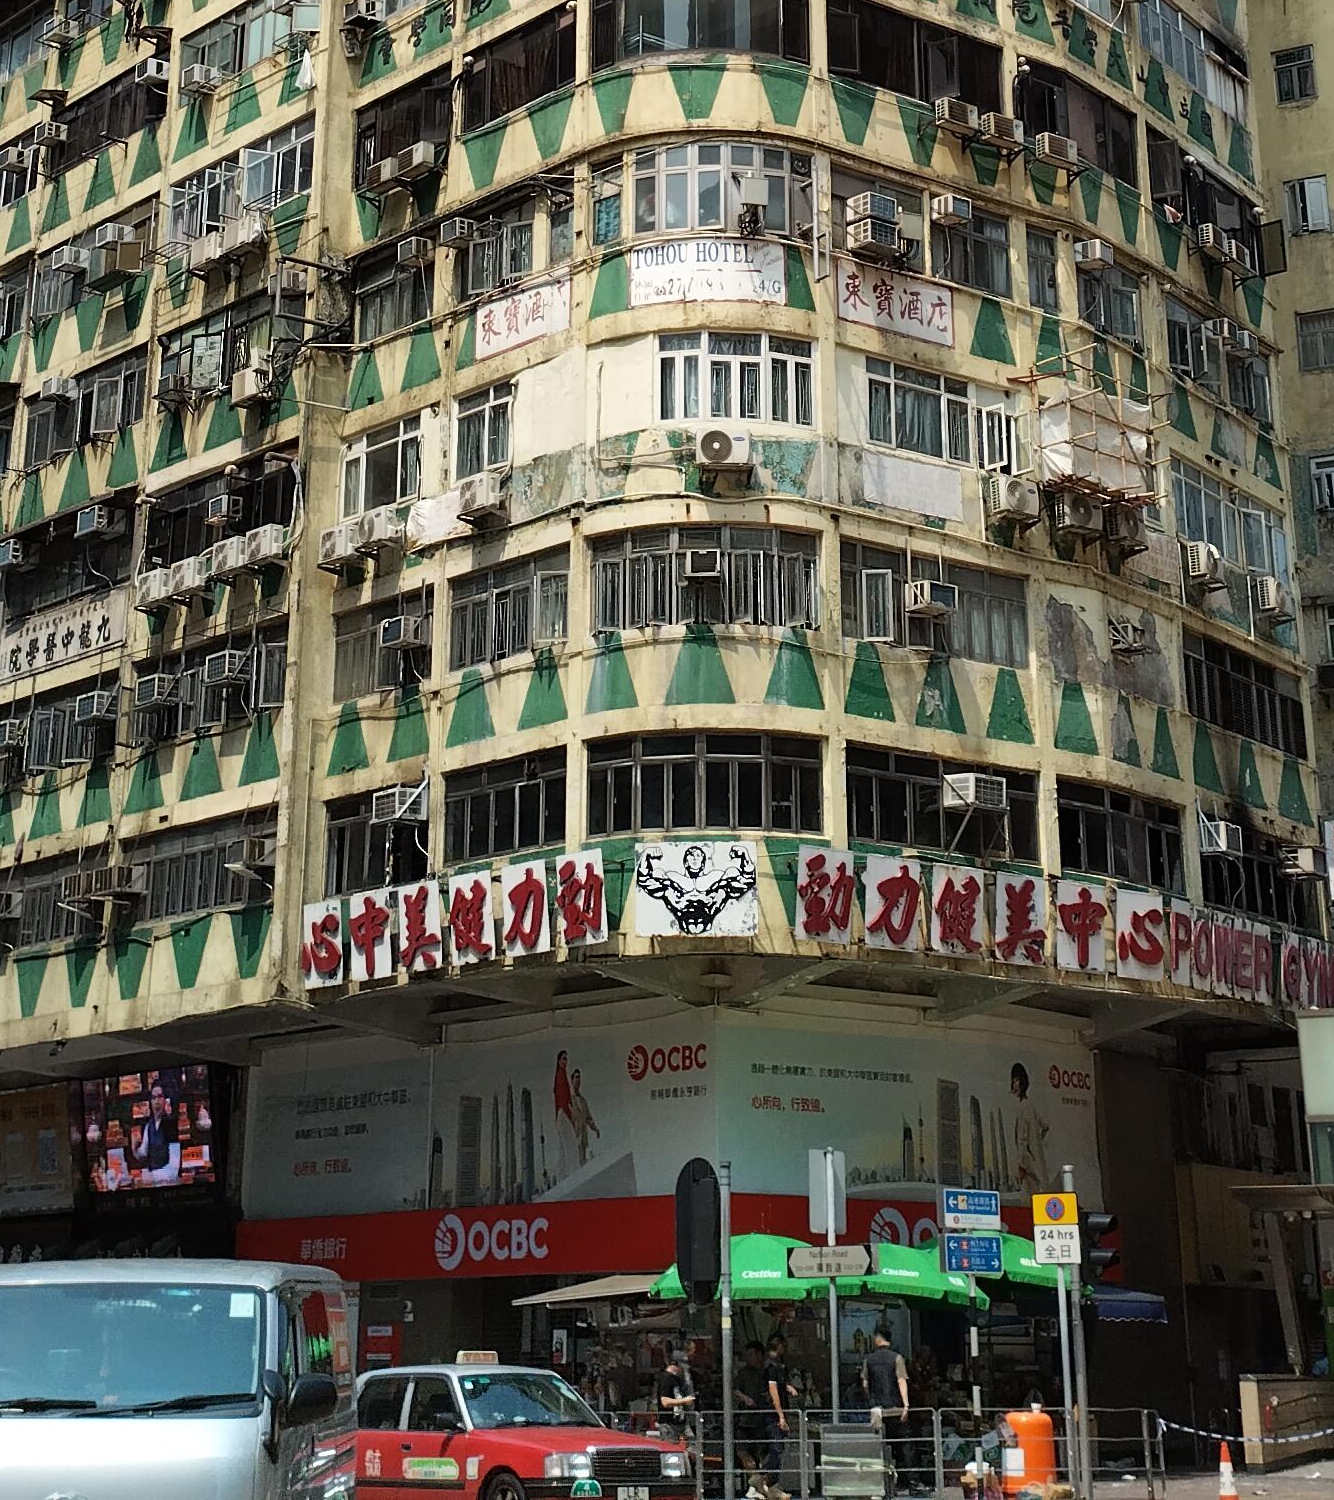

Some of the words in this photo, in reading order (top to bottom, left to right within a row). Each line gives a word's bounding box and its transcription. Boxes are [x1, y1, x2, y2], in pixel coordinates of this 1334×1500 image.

[633, 243, 688, 269] TOHOU
[695, 243, 754, 263] HOTEL
[798, 854, 1164, 969] 勁力健美中心
[1170, 912, 1272, 995] POWER
[651, 1044, 707, 1073] OCBC
[1062, 1070, 1092, 1090] OCBC
[468, 1217, 550, 1262] OCBC
[1040, 1230, 1054, 1240] 24
[1058, 1230, 1074, 1240] hrs
[1044, 1244, 1072, 1259] 全日
